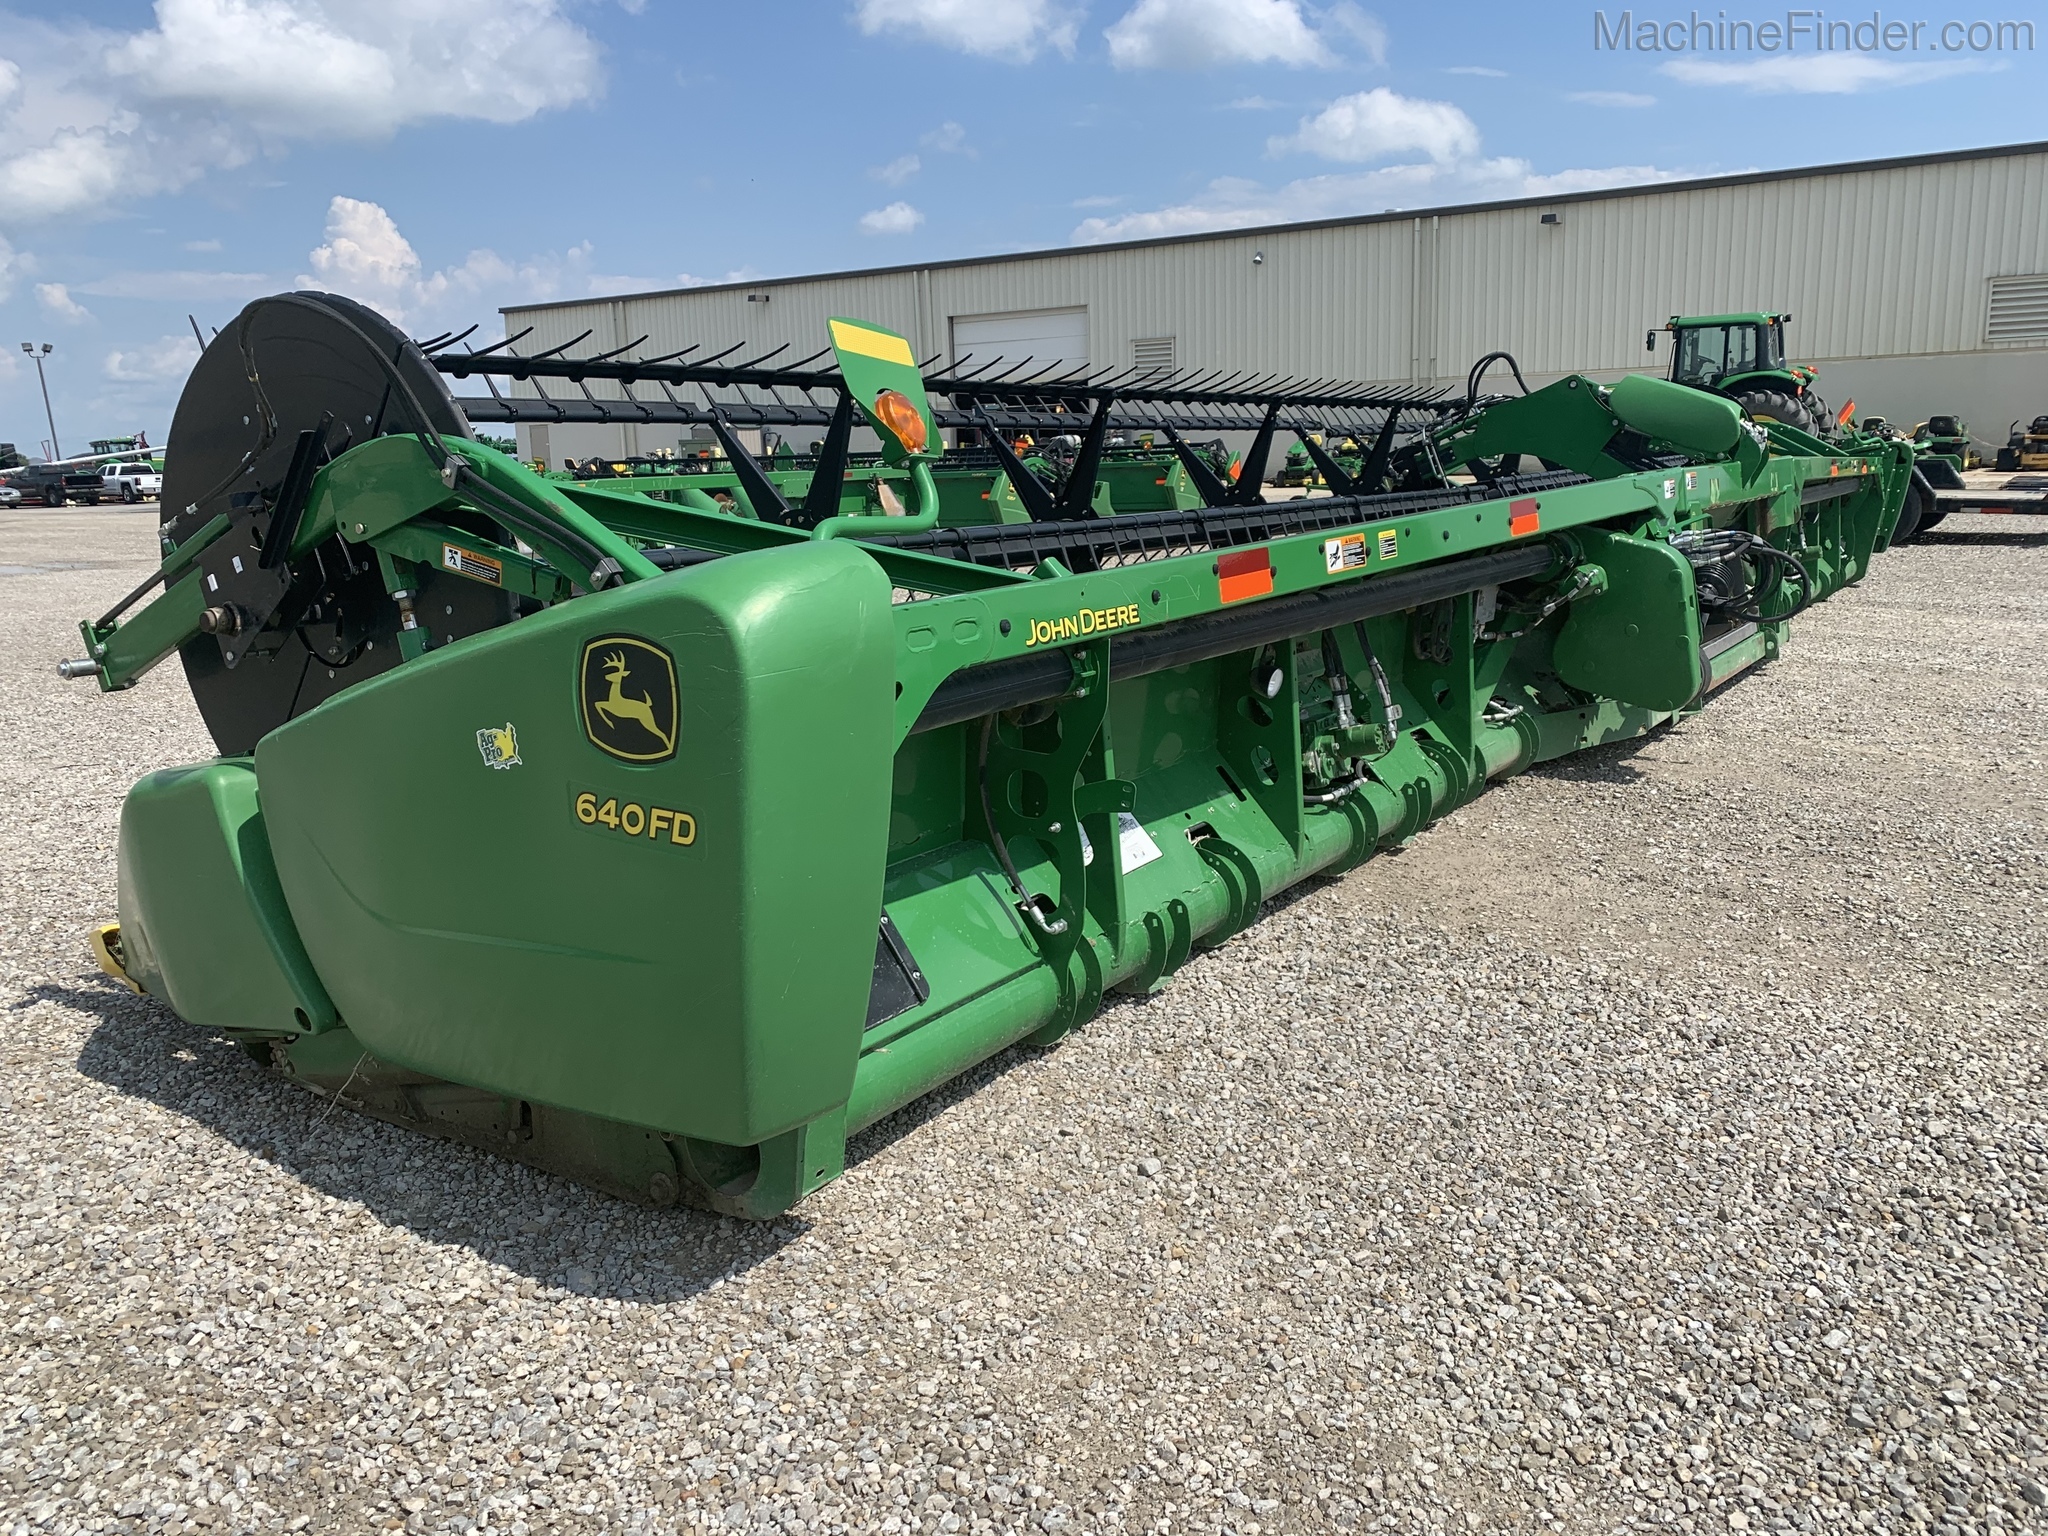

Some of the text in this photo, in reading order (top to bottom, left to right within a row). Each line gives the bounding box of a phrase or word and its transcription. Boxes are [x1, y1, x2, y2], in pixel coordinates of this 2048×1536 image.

[1025, 604, 1140, 647] JOHN DEERE
[483, 746, 503, 762] Pro
[575, 792, 698, 847] 640FD
